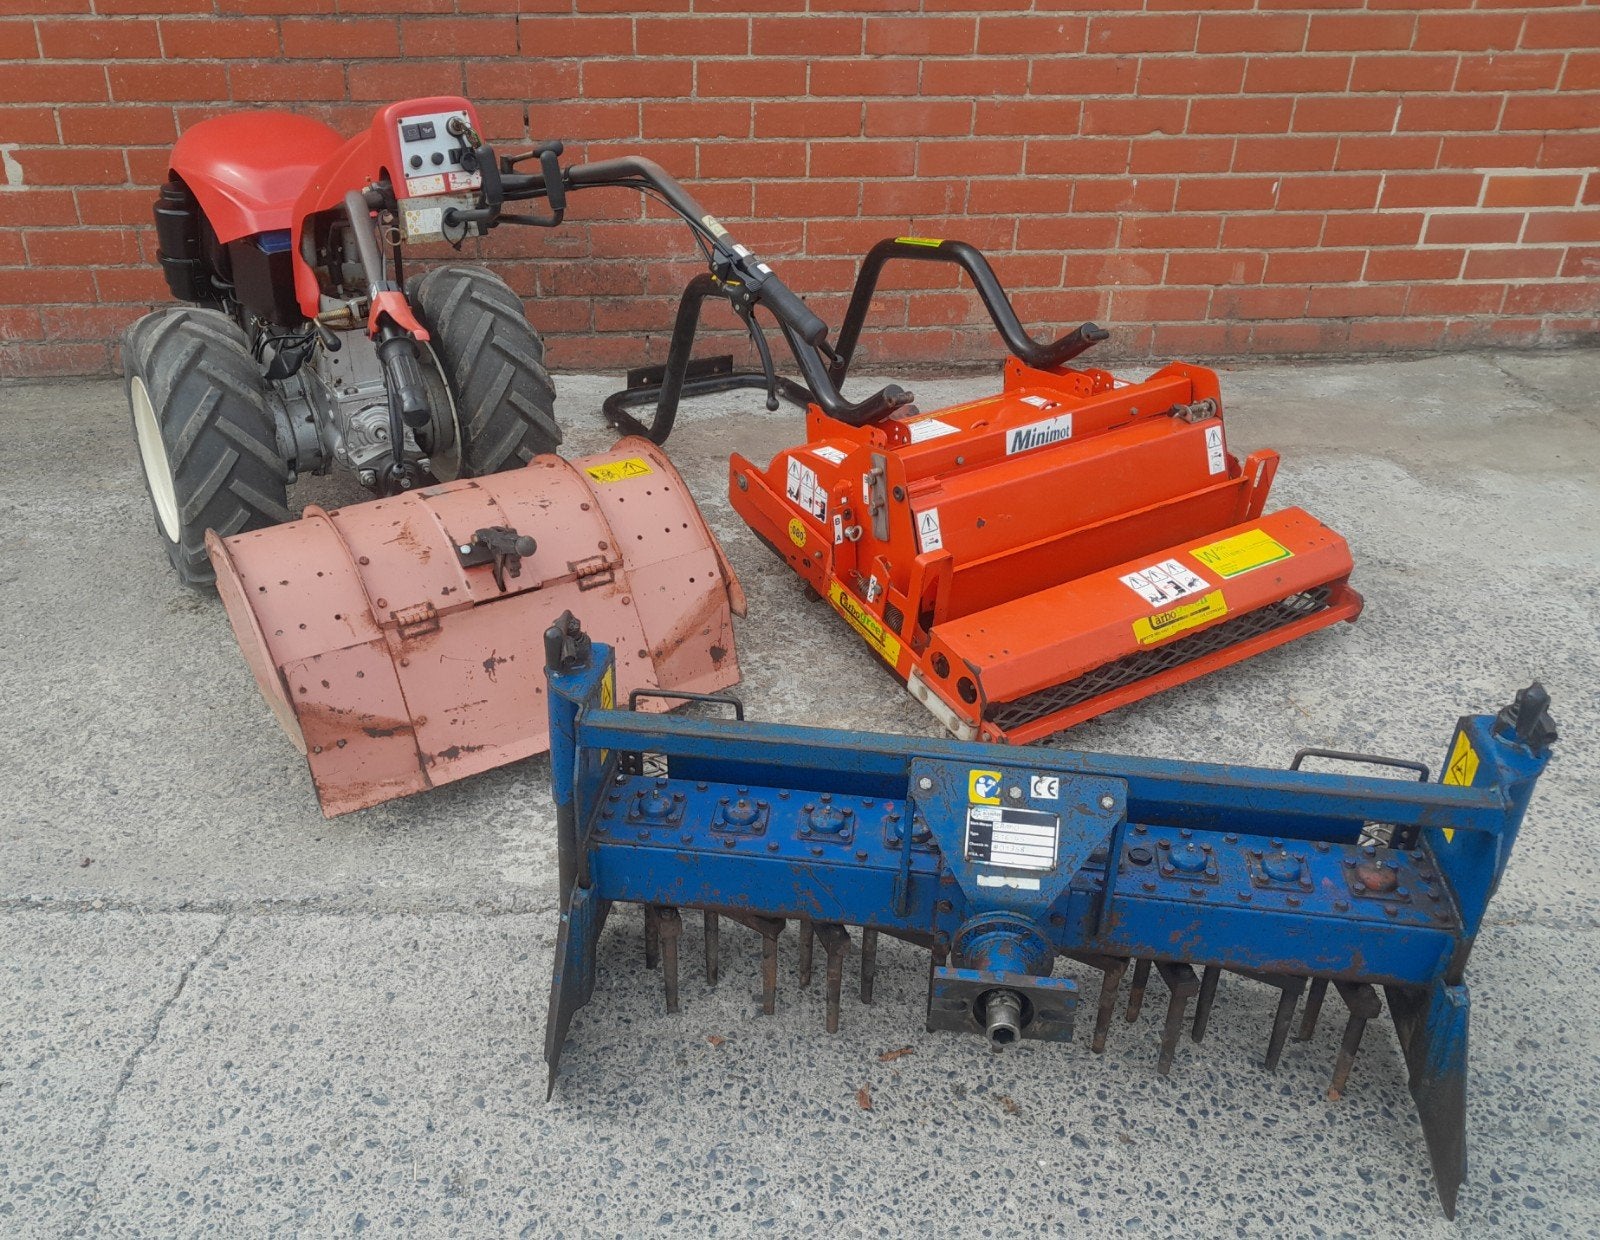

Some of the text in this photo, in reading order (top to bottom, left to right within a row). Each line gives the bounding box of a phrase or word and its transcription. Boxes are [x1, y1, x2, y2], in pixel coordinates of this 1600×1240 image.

[1011, 425, 1070, 453] Minimot
[840, 591, 885, 641] Carbogree
[1033, 780, 1057, 797] CE
